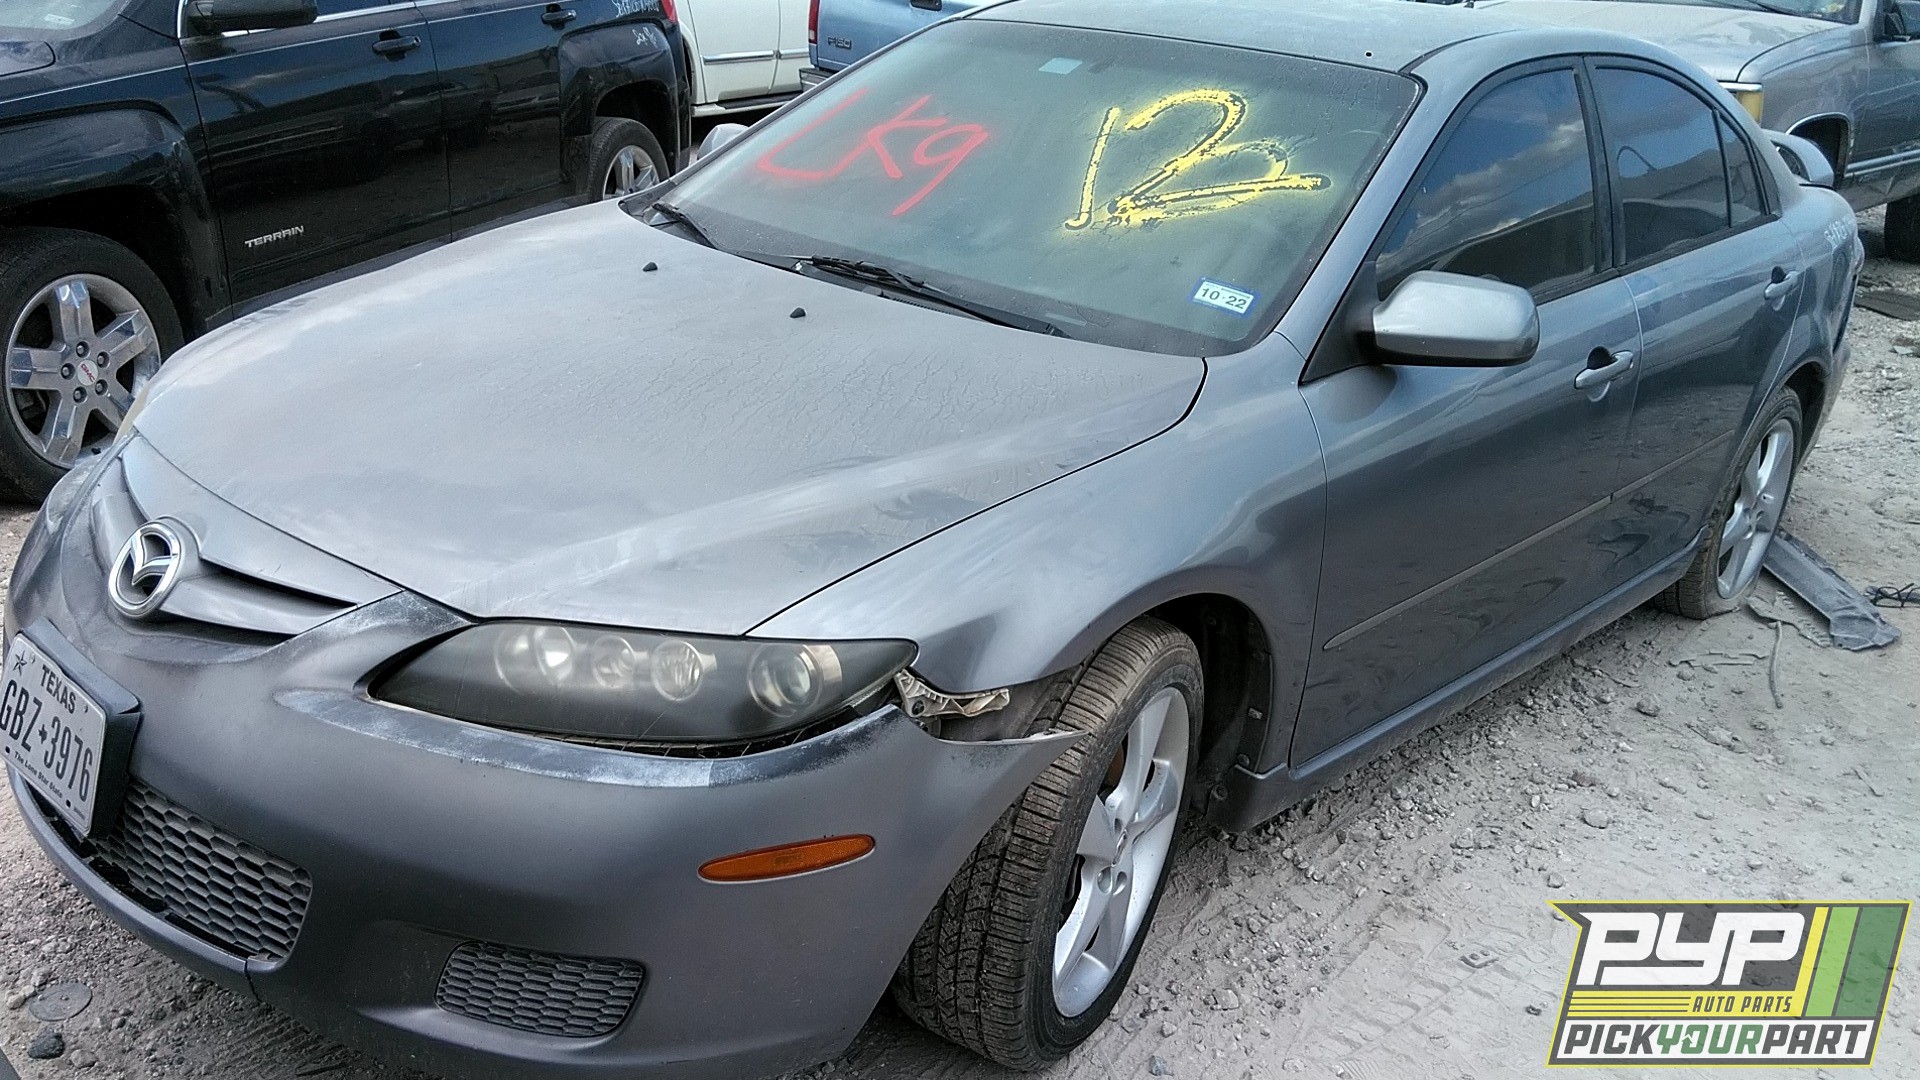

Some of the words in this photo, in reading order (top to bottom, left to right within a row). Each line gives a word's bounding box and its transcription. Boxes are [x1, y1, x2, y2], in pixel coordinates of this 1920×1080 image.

[244, 225, 304, 248] TERRAIN
[80, 363, 96, 383] GMC
[41, 664, 76, 714] TEXAS
[14, 750, 24, 764] The
[24, 760, 38, 776] Lone
[37, 771, 50, 786] Star
[48, 781, 63, 798] State
